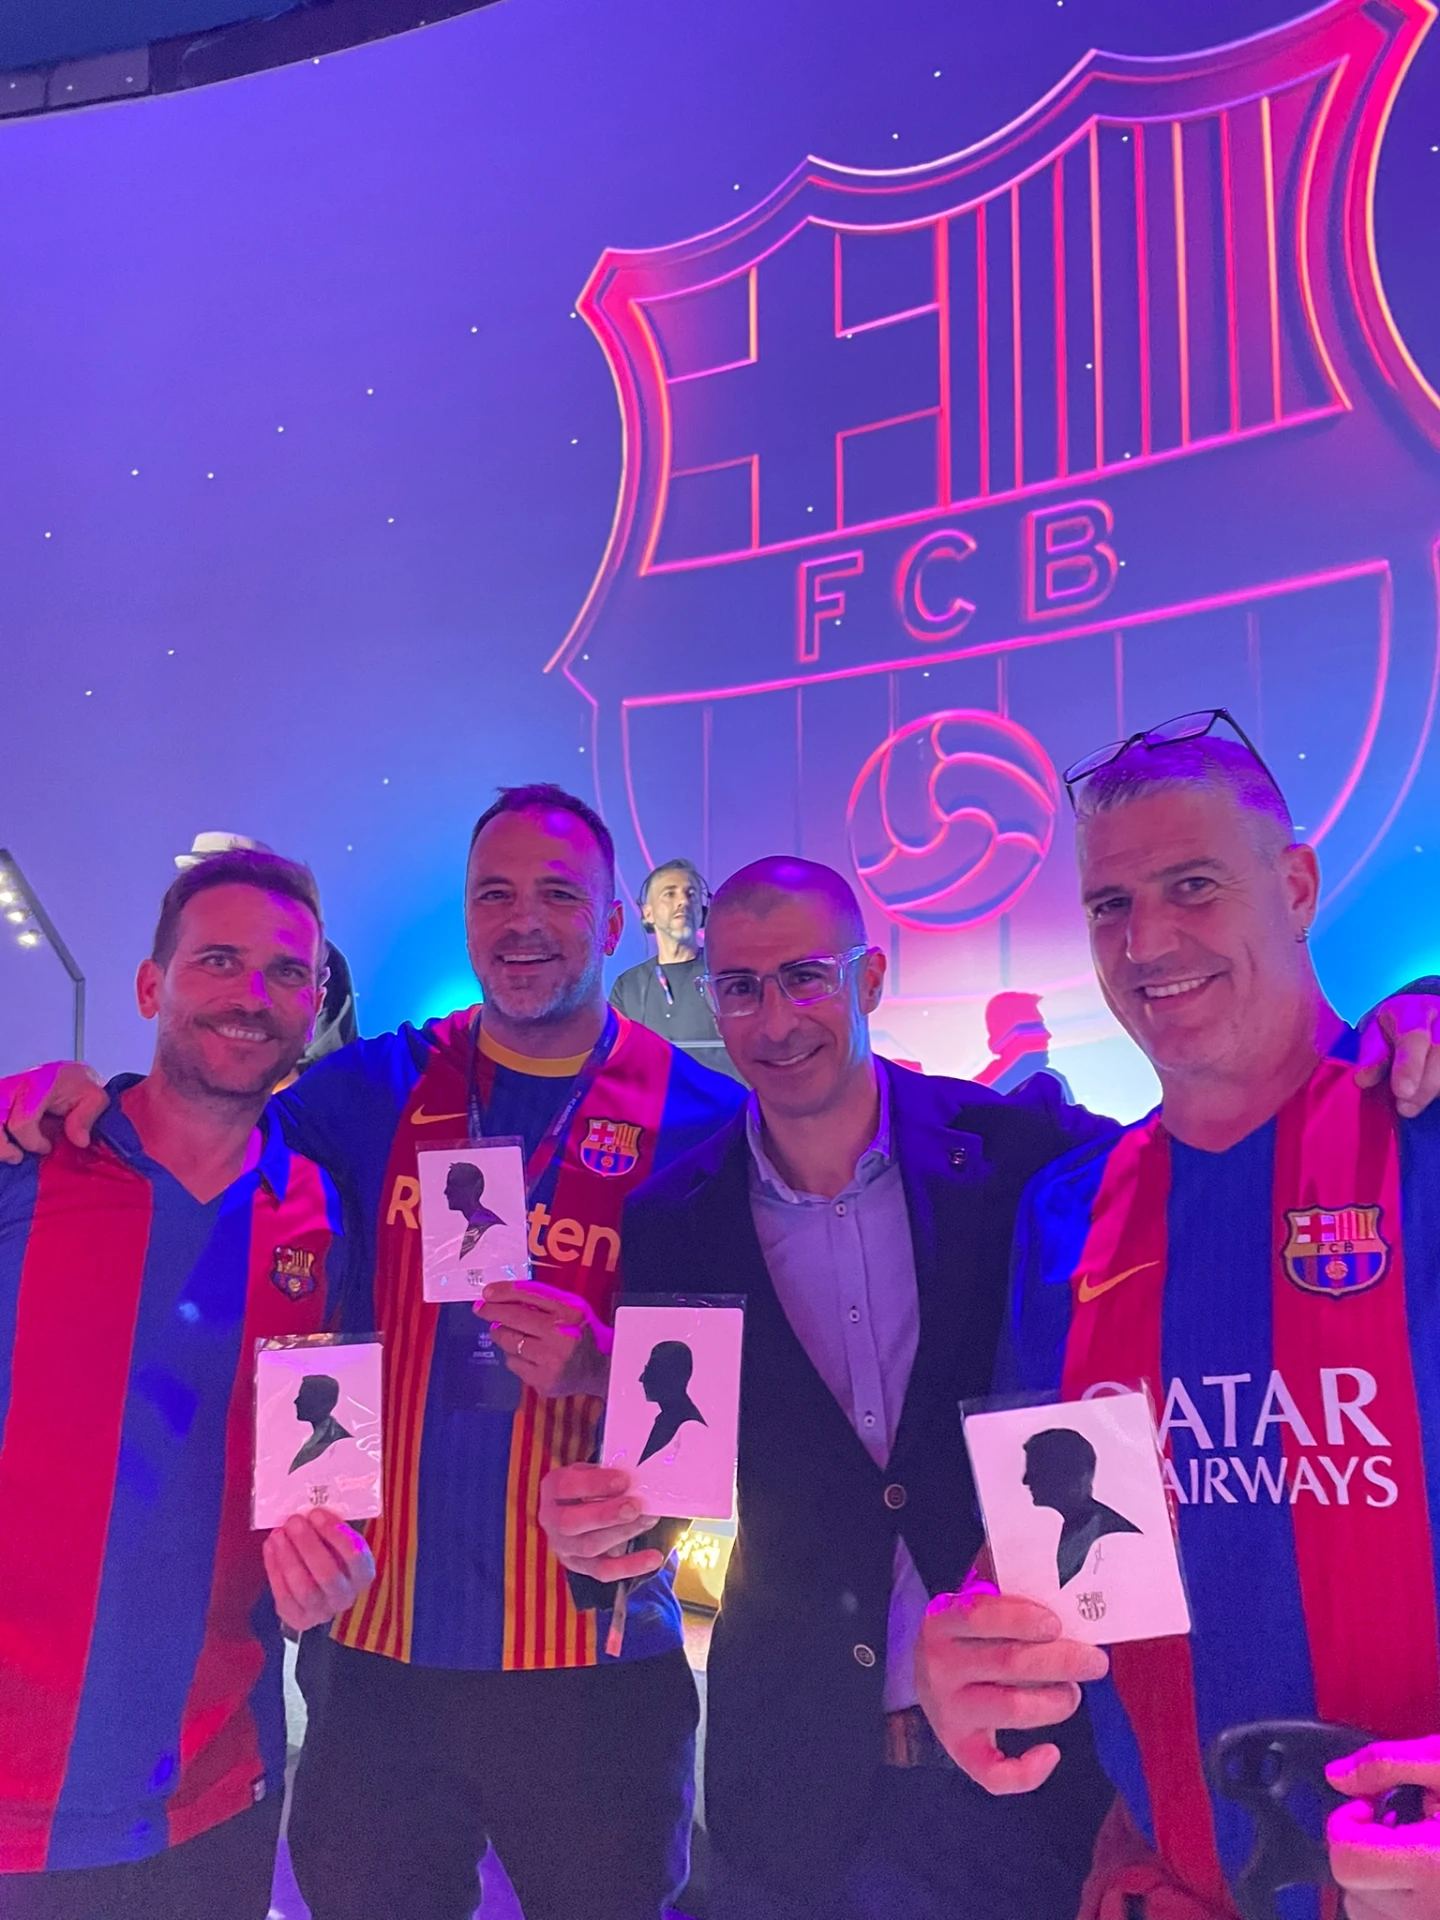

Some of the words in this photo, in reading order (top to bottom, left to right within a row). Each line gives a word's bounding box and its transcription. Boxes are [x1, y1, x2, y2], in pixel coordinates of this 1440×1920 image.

[797, 499, 1118, 664] FCB
[386, 1174, 621, 1273] Rten
[1316, 1241, 1354, 1254] FCB
[1081, 1367, 1392, 1450] ATAR
[1161, 1455, 1399, 1508] AIRWAYS
